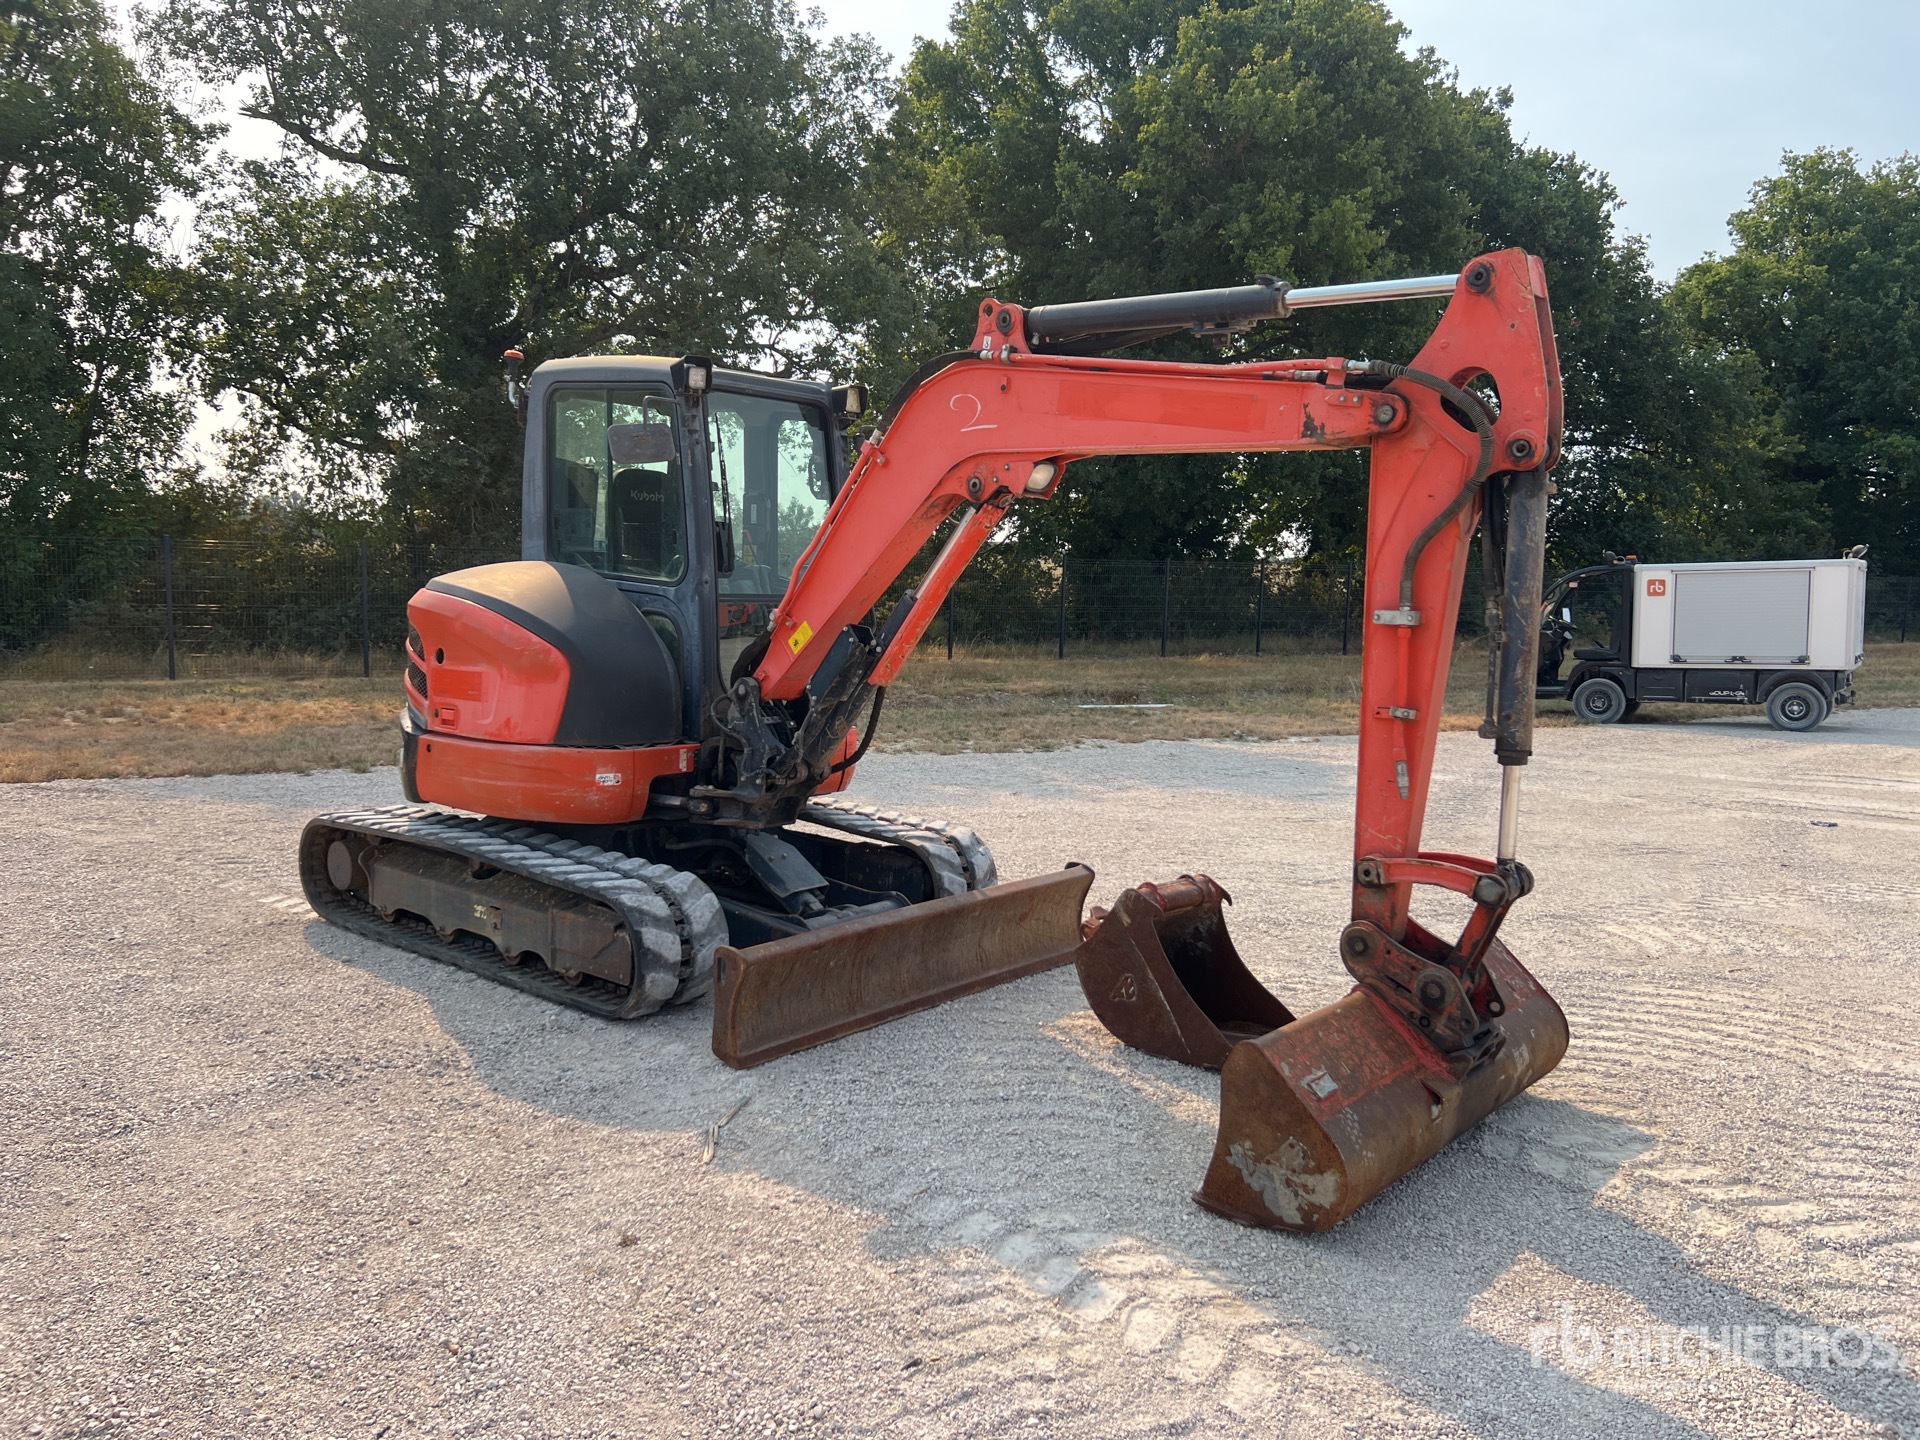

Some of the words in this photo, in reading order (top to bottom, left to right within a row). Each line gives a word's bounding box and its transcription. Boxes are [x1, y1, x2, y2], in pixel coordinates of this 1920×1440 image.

[949, 393, 998, 432] 2
[630, 489, 665, 502] Kubota
[1650, 580, 1664, 593] rb
